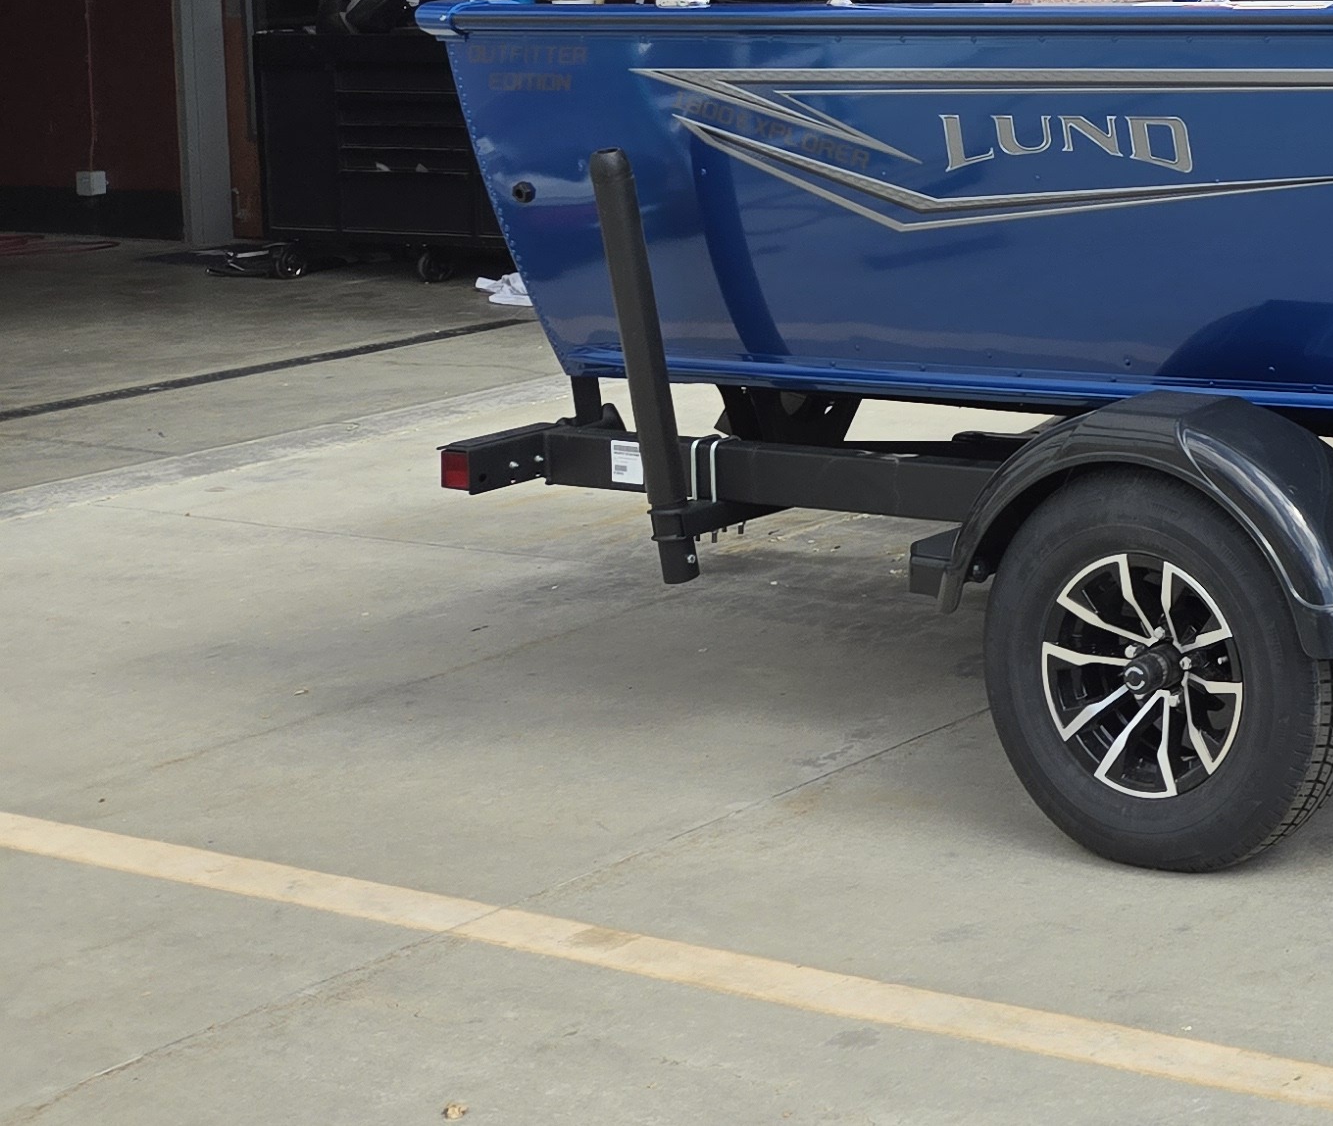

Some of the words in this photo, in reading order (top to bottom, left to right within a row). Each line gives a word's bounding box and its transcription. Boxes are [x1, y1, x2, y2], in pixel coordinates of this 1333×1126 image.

[467, 43, 588, 65] OUTFITTER
[488, 72, 572, 91] EDITION
[736, 110, 870, 171] EXPLORER
[938, 114, 1193, 173] LUND
